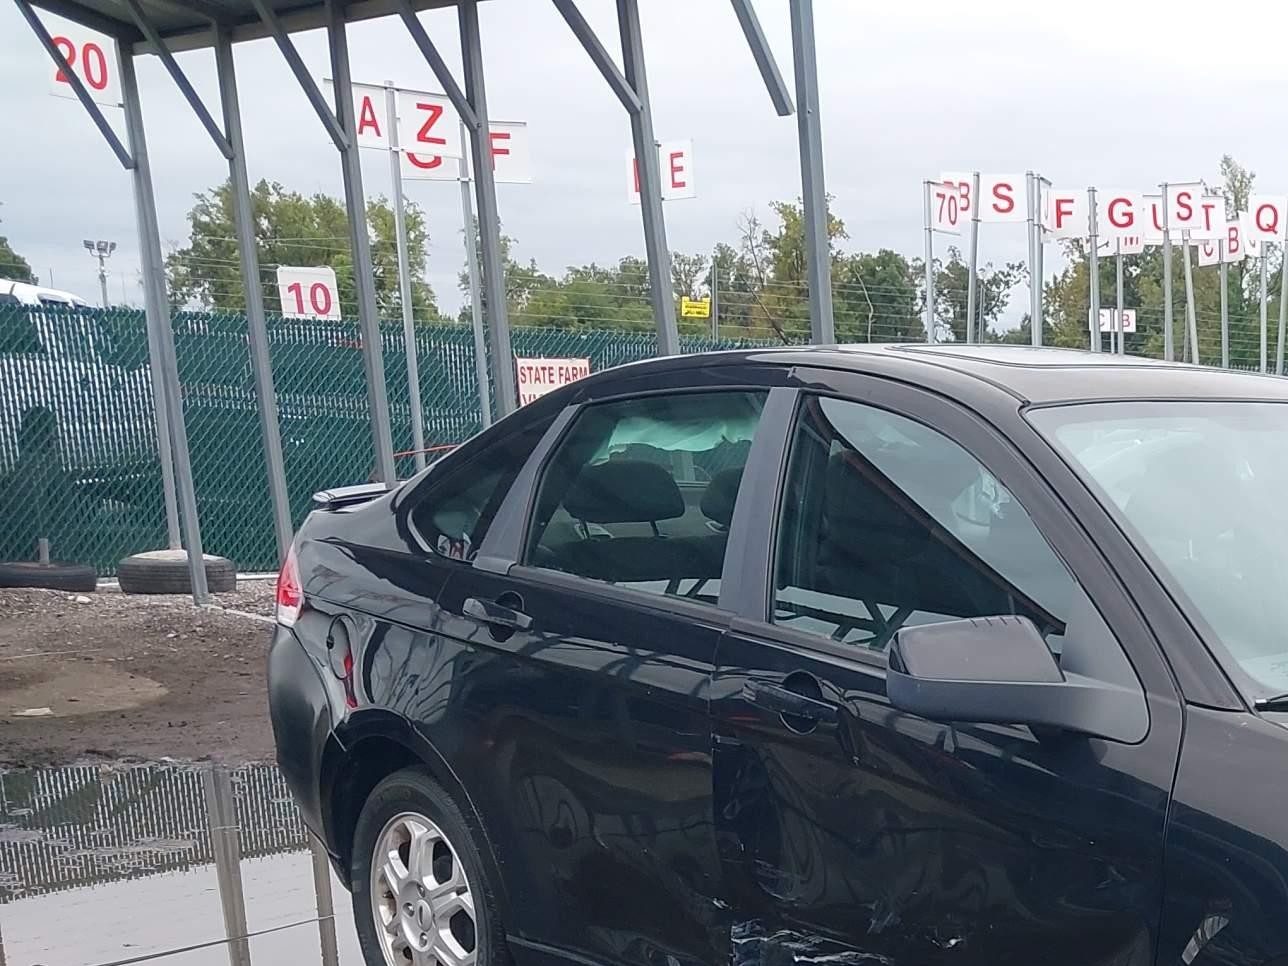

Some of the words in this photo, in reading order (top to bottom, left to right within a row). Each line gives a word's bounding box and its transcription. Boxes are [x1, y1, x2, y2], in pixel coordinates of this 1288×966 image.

[357, 96, 382, 137] A
[416, 103, 447, 145] Z
[670, 151, 687, 188] E
[936, 192, 958, 226] 70
[992, 182, 1015, 213] S
[1055, 198, 1074, 229] F
[1108, 197, 1134, 229] G
[1176, 192, 1193, 222] S
[1201, 203, 1215, 231] T
[1255, 203, 1279, 235] Q
[1228, 226, 1239, 254] B
[288, 282, 333, 315] 10
[520, 366, 555, 384] STATE
[558, 366, 588, 384] FARM
